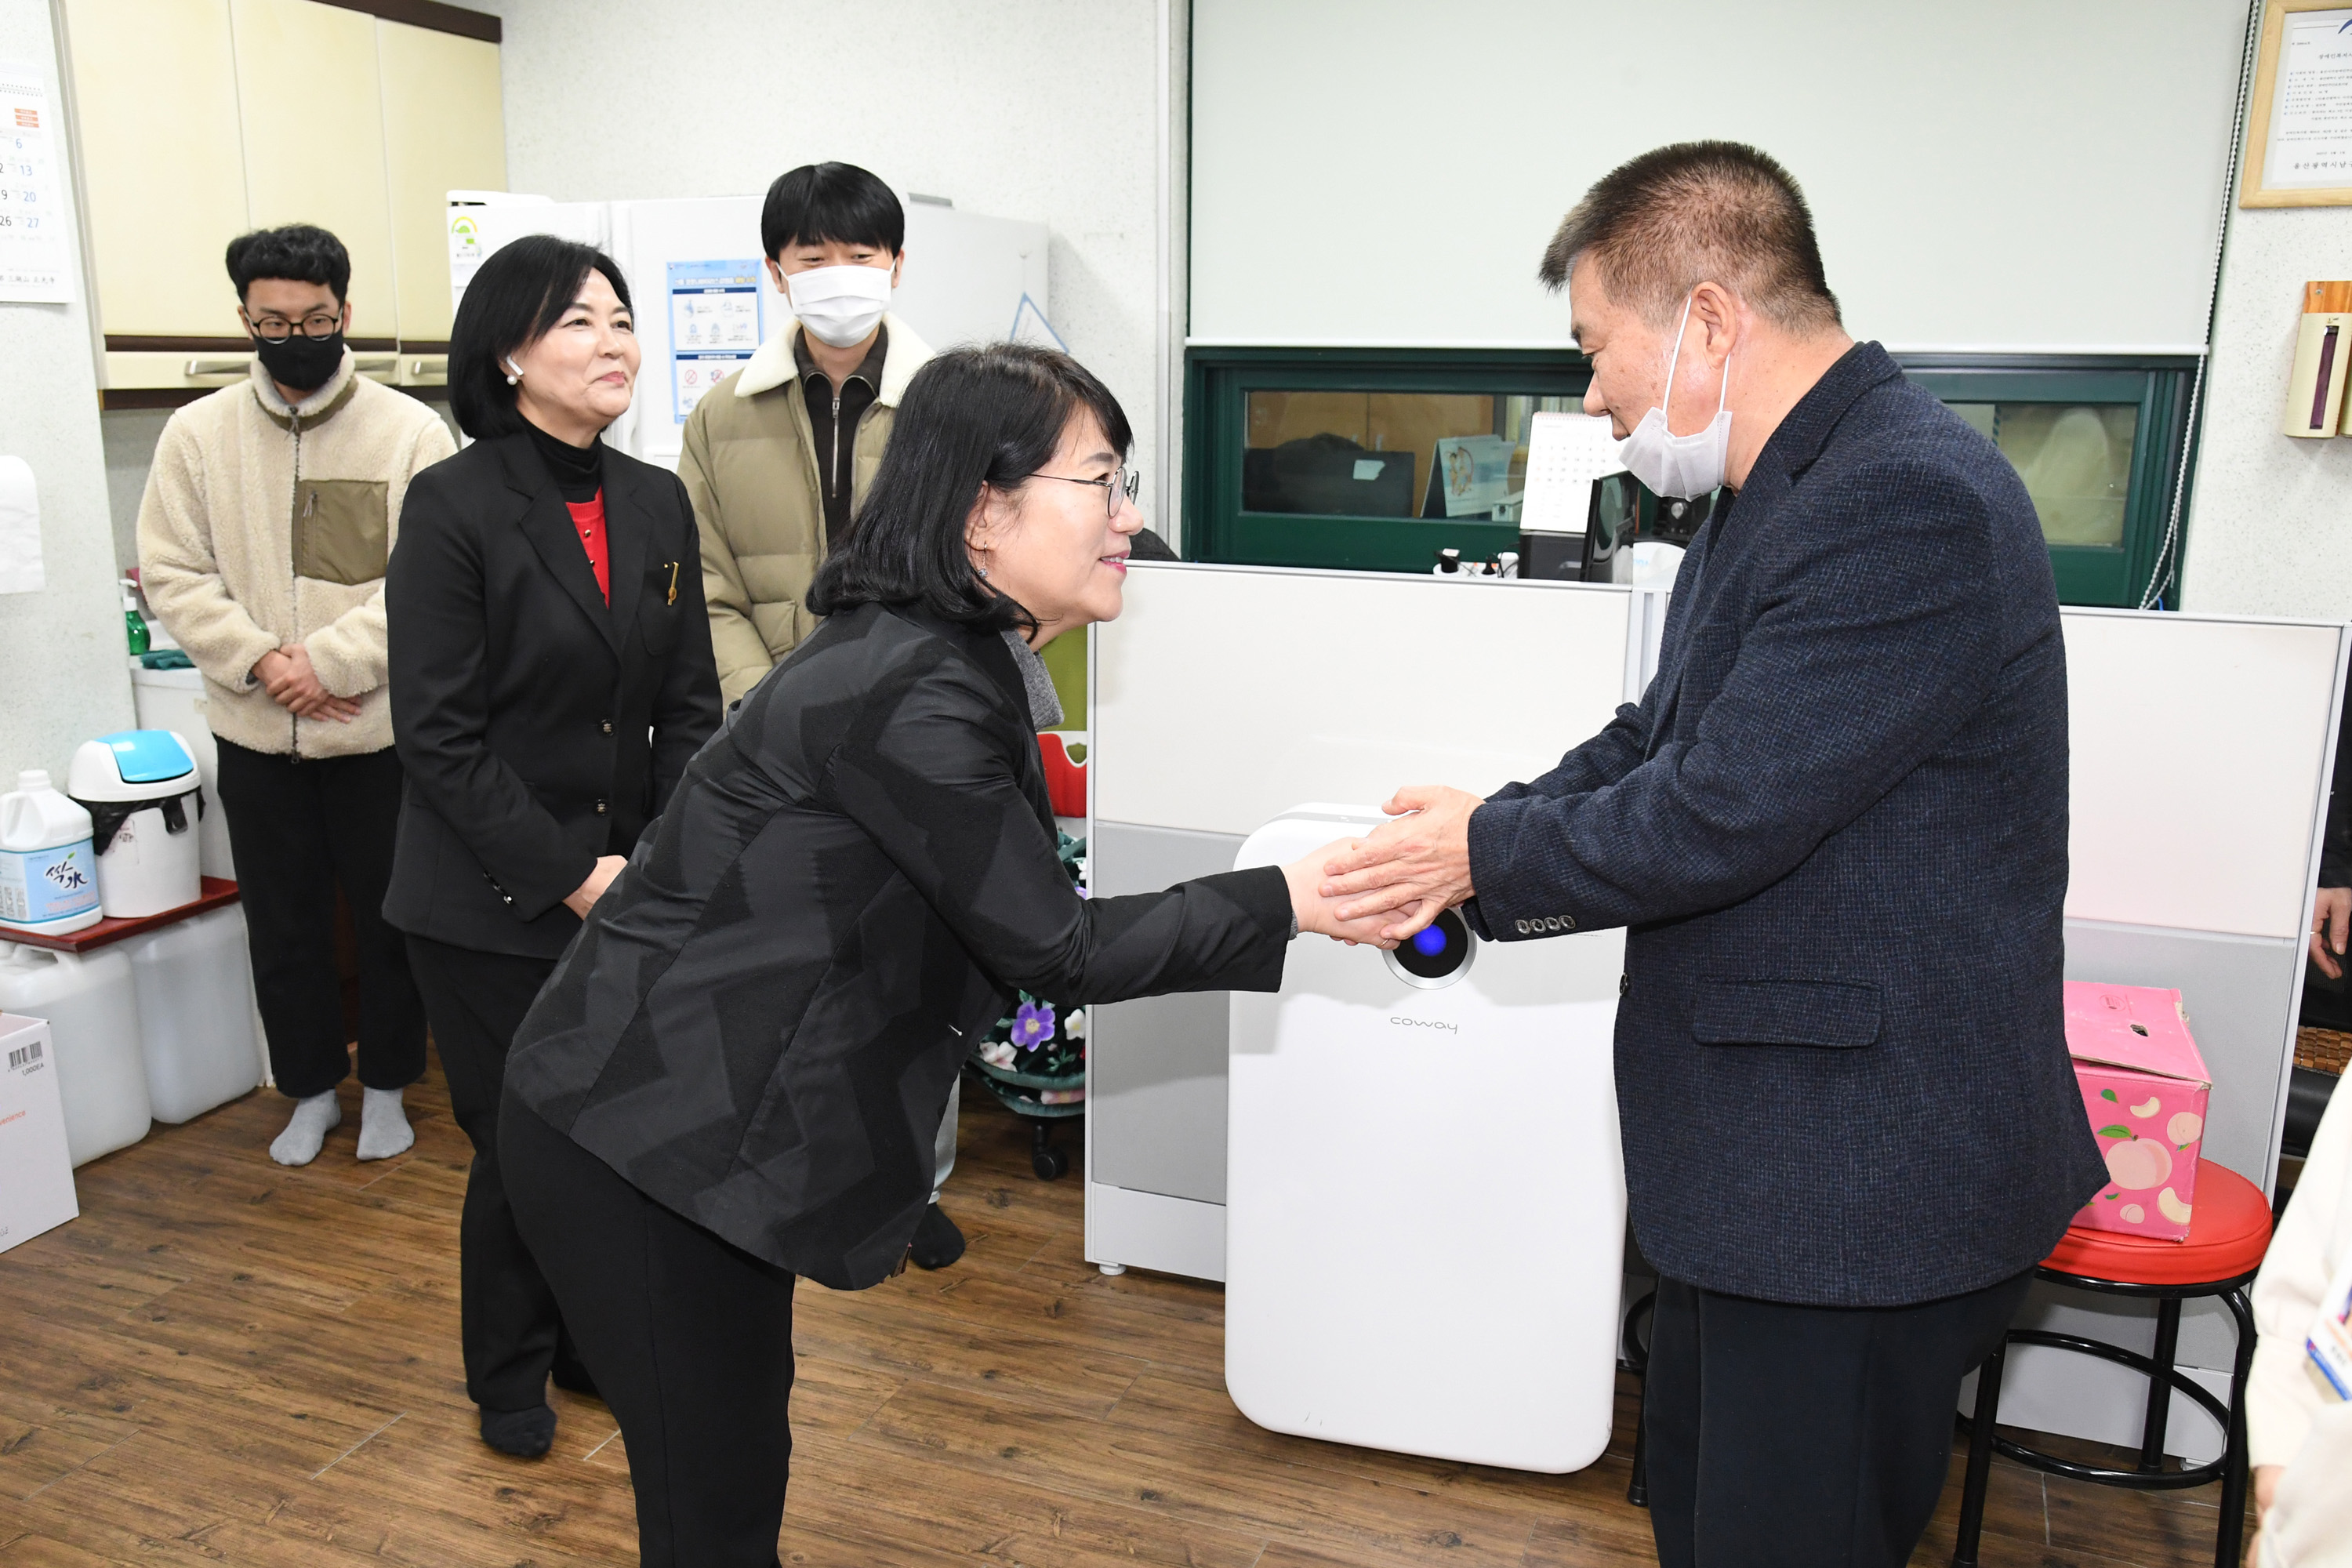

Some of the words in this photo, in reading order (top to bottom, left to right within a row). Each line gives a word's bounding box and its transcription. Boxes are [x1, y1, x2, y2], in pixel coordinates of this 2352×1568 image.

[16, 138, 22, 149] 6
[0, 162, 4, 173] 2
[20, 165, 32, 176] 13
[2, 189, 8, 200] 9
[23, 191, 36, 202] 20
[0, 216, 12, 227] 26
[27, 217, 39, 228] 27
[1390, 1017, 1457, 1035] coway
[22, 1064, 44, 1076] 1,000EA
